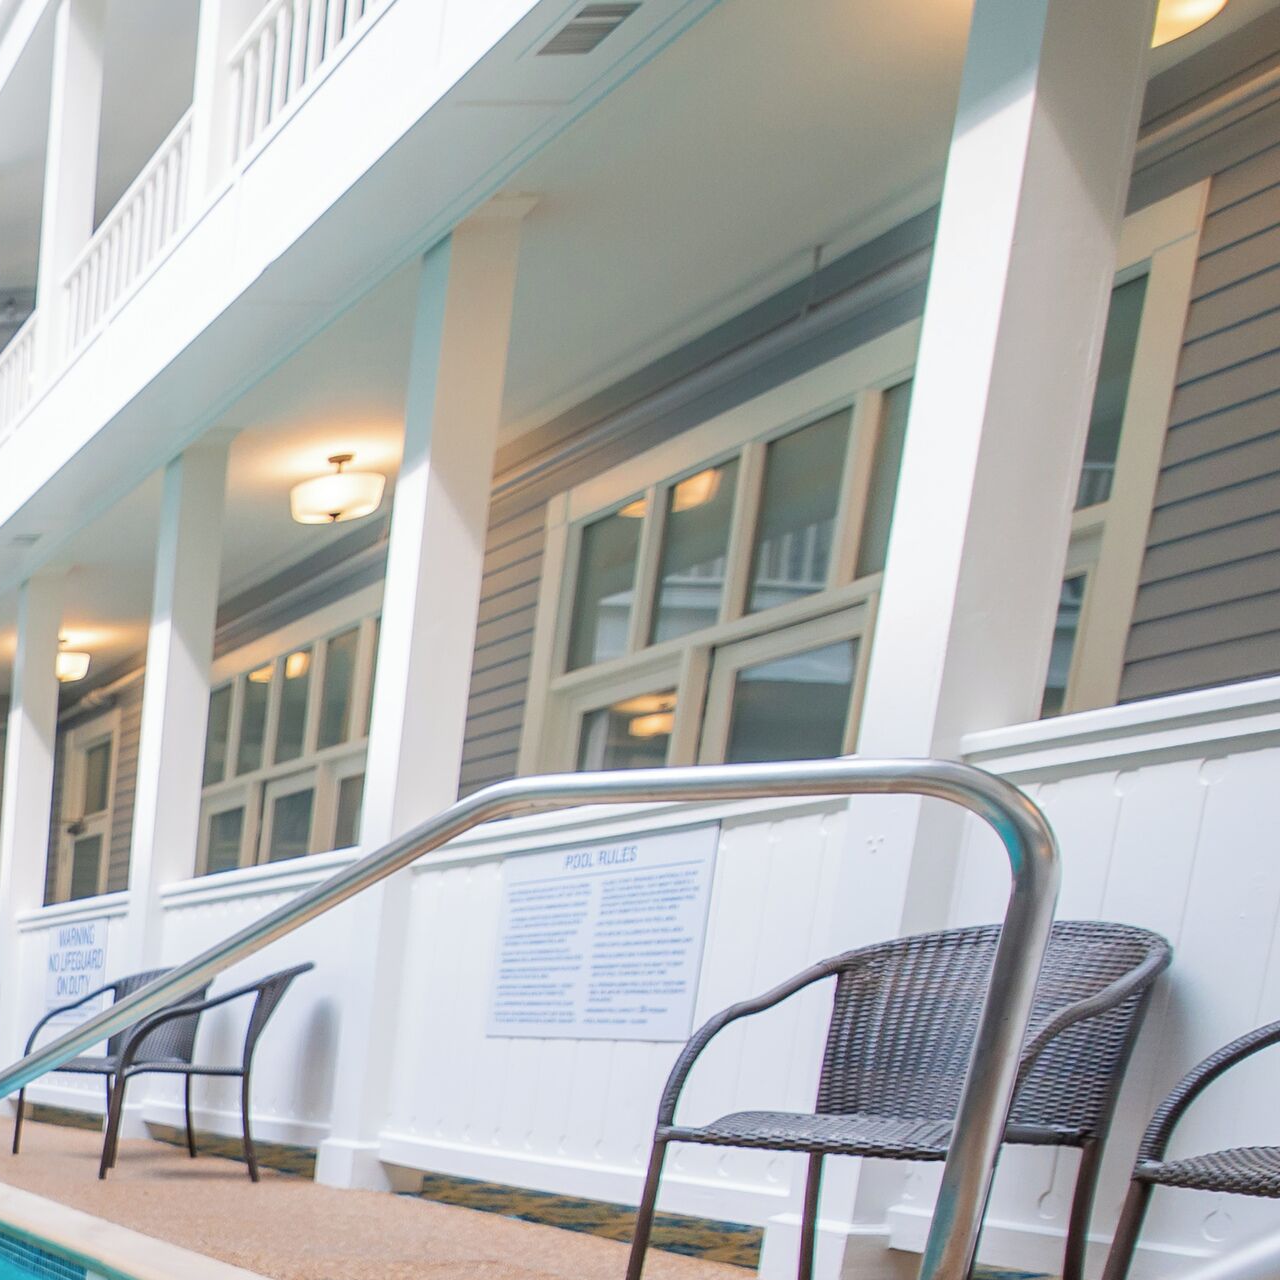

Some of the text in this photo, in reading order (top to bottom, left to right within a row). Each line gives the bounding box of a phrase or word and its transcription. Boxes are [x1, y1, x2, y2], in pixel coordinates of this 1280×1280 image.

[564, 845, 638, 869] POOL RULES
[58, 923, 95, 948] WARNING
[48, 948, 104, 973] NO LIFEGUARD
[56, 974, 91, 995] ON DUTY
